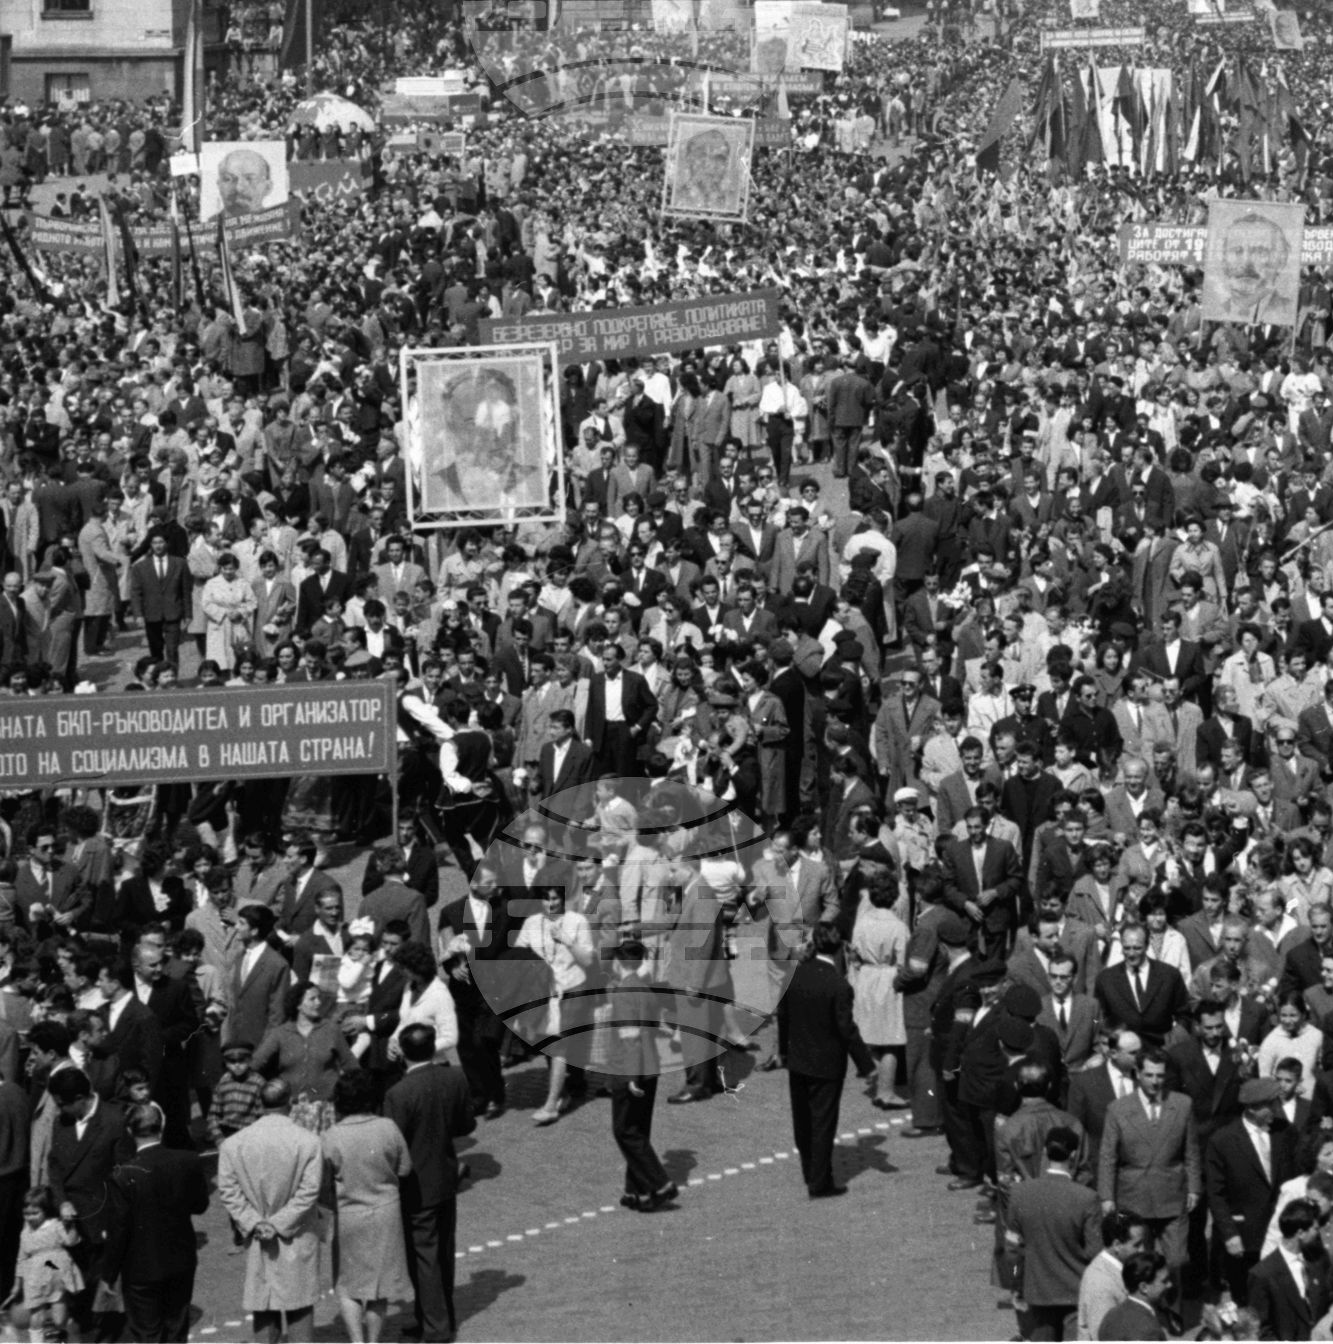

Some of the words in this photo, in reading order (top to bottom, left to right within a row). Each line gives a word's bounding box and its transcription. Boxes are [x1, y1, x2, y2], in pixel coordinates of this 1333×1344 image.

[492, 321, 587, 343] БЕЗРЕЗЕРВНО
[594, 311, 678, 335] ПОДКРЕПЯМЕ
[685, 299, 766, 324] ПОЛИТИКАТА
[579, 336, 597, 353] ЗА
[604, 334, 630, 352] МИР
[636, 333, 648, 348] И
[654, 315, 768, 345] РАЗОРЪЖАВАНЕ!
[0, 715, 47, 739] НАТА
[57, 706, 229, 738] БКП-РЪКОВОДИТЕЛ
[239, 705, 251, 728] И
[38, 750, 61, 775] НА
[72, 745, 189, 774] СОЦИАЛИЗМА
[199, 744, 210, 768] В
[220, 740, 289, 766] НАШАТА
[299, 731, 375, 762] СТРАНА!
